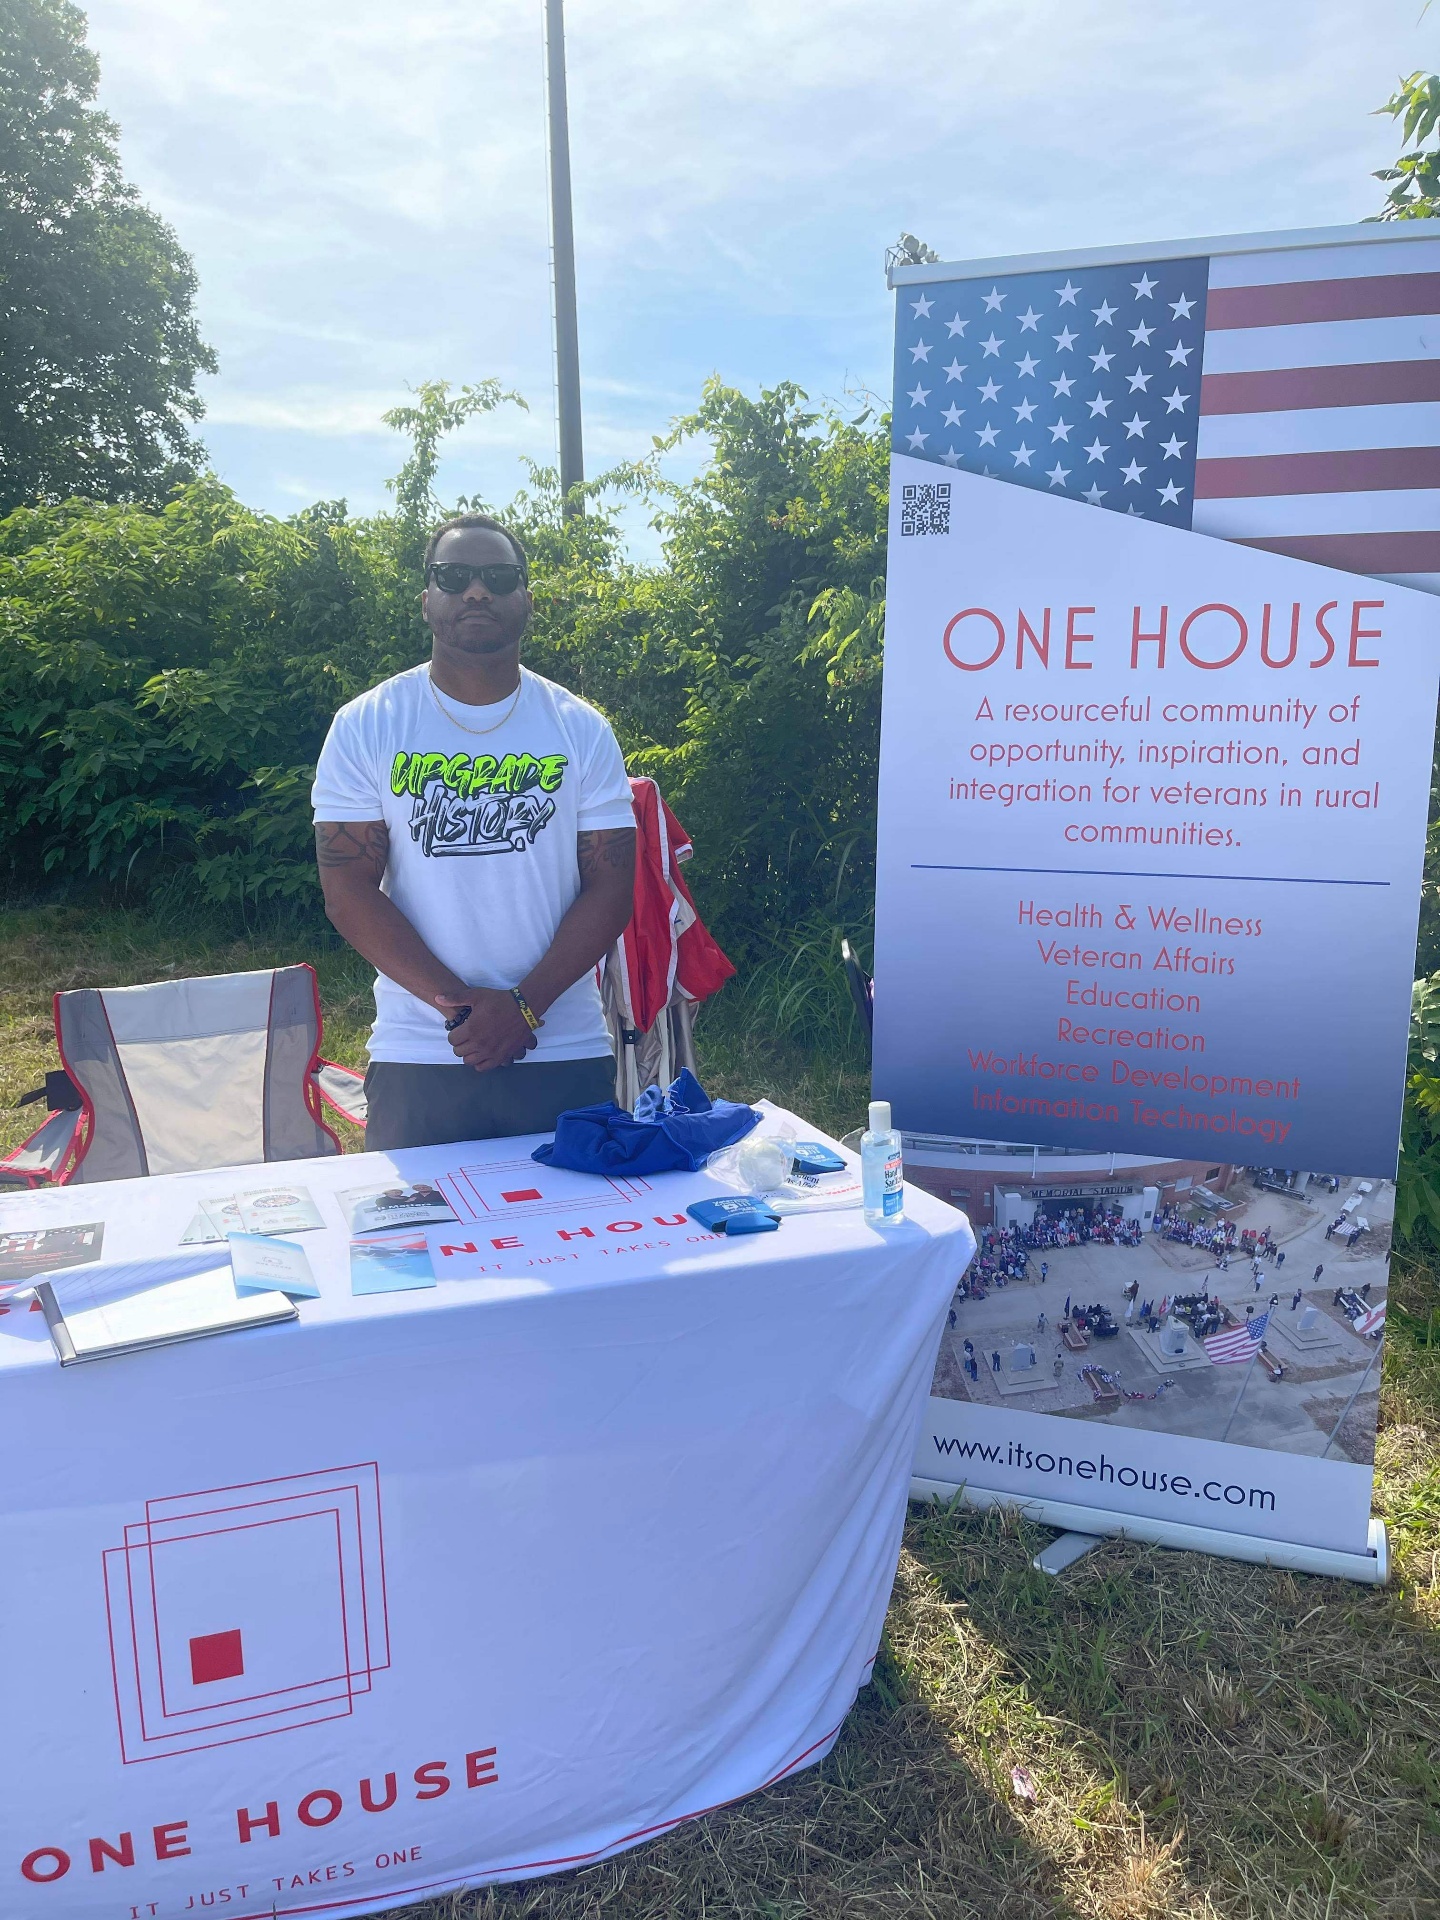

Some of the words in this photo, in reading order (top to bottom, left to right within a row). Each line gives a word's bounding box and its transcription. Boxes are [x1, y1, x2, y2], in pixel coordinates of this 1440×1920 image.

[943, 607, 1095, 671] ONE
[1131, 601, 1384, 669] HOUSE
[975, 696, 995, 722] A
[1006, 696, 1150, 723] resourceful
[1162, 698, 1316, 729] community
[1329, 695, 1360, 723] of
[970, 740, 1124, 768] opportunity,
[1139, 740, 1287, 768] inspiration,
[1302, 740, 1360, 766] and
[391, 751, 569, 799] UPGRADE
[950, 778, 1091, 807] integration
[1104, 778, 1139, 803] for
[1150, 781, 1266, 806] veterans
[1280, 784, 1302, 806] in
[1316, 782, 1379, 809] rural
[1064, 823, 1242, 846] communities.
[1018, 901, 1102, 930] Health
[1115, 905, 1136, 930] &
[1148, 906, 1261, 936] Wellness
[1038, 940, 1143, 969] Veteran
[1153, 947, 1234, 975] Affairs
[1067, 980, 1200, 1012] Education
[1058, 1017, 1205, 1051] Recreation
[968, 1049, 1099, 1082] Workforce
[1112, 1059, 1301, 1100] Development
[973, 1087, 1118, 1122] Information
[1130, 1099, 1292, 1144] Technology
[439, 1236, 525, 1257] NE
[558, 1214, 687, 1240] HOU
[478, 1263, 503, 1273] IT
[526, 1253, 580, 1267] JUST
[600, 1239, 671, 1256] TAKES
[932, 1434, 1276, 1512] www.itsonehouse.com
[21, 1821, 192, 1883] ONE
[237, 1747, 499, 1843] HOUSE
[130, 1902, 159, 1920] IT
[185, 1884, 249, 1909] JUST
[273, 1861, 356, 1891] TAKES
[375, 1845, 423, 1869] ONE
